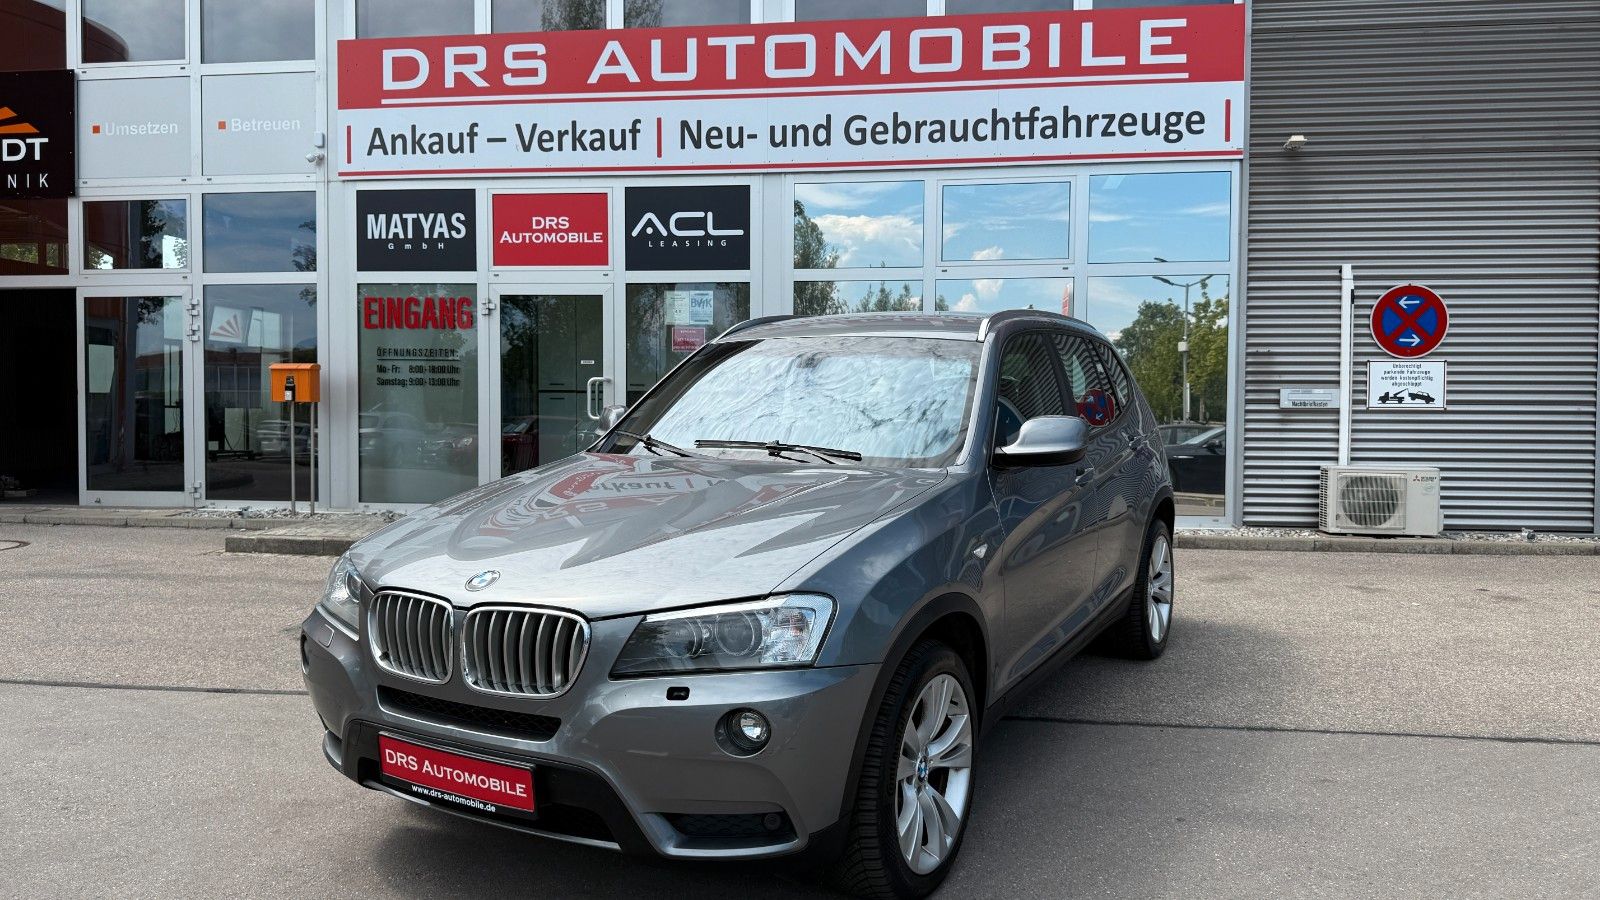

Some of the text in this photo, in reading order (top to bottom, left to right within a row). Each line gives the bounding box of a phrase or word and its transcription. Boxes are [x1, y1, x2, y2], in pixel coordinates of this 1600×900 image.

[382, 18, 1188, 91] DRS AUTOMOBILE
[105, 121, 179, 136] Umsetzen
[231, 117, 301, 132] Betreuen
[366, 123, 479, 156] Ankauf
[515, 118, 641, 152] Verkauf
[679, 119, 758, 150] Neu-
[770, 113, 832, 148] und
[844, 105, 1206, 145] Gebrauchtfahrzeuge
[366, 212, 467, 241] MATYAS
[532, 216, 570, 230] DRS
[631, 211, 744, 237] ACL
[388, 242, 445, 251] GmbH
[500, 230, 603, 245] AUTOMOBILE
[648, 240, 727, 248] LEASING
[364, 296, 474, 330] EINGANG
[385, 748, 528, 798] DRS AUTOMOBILE
[411, 784, 496, 812] www.drs-automobile.de
